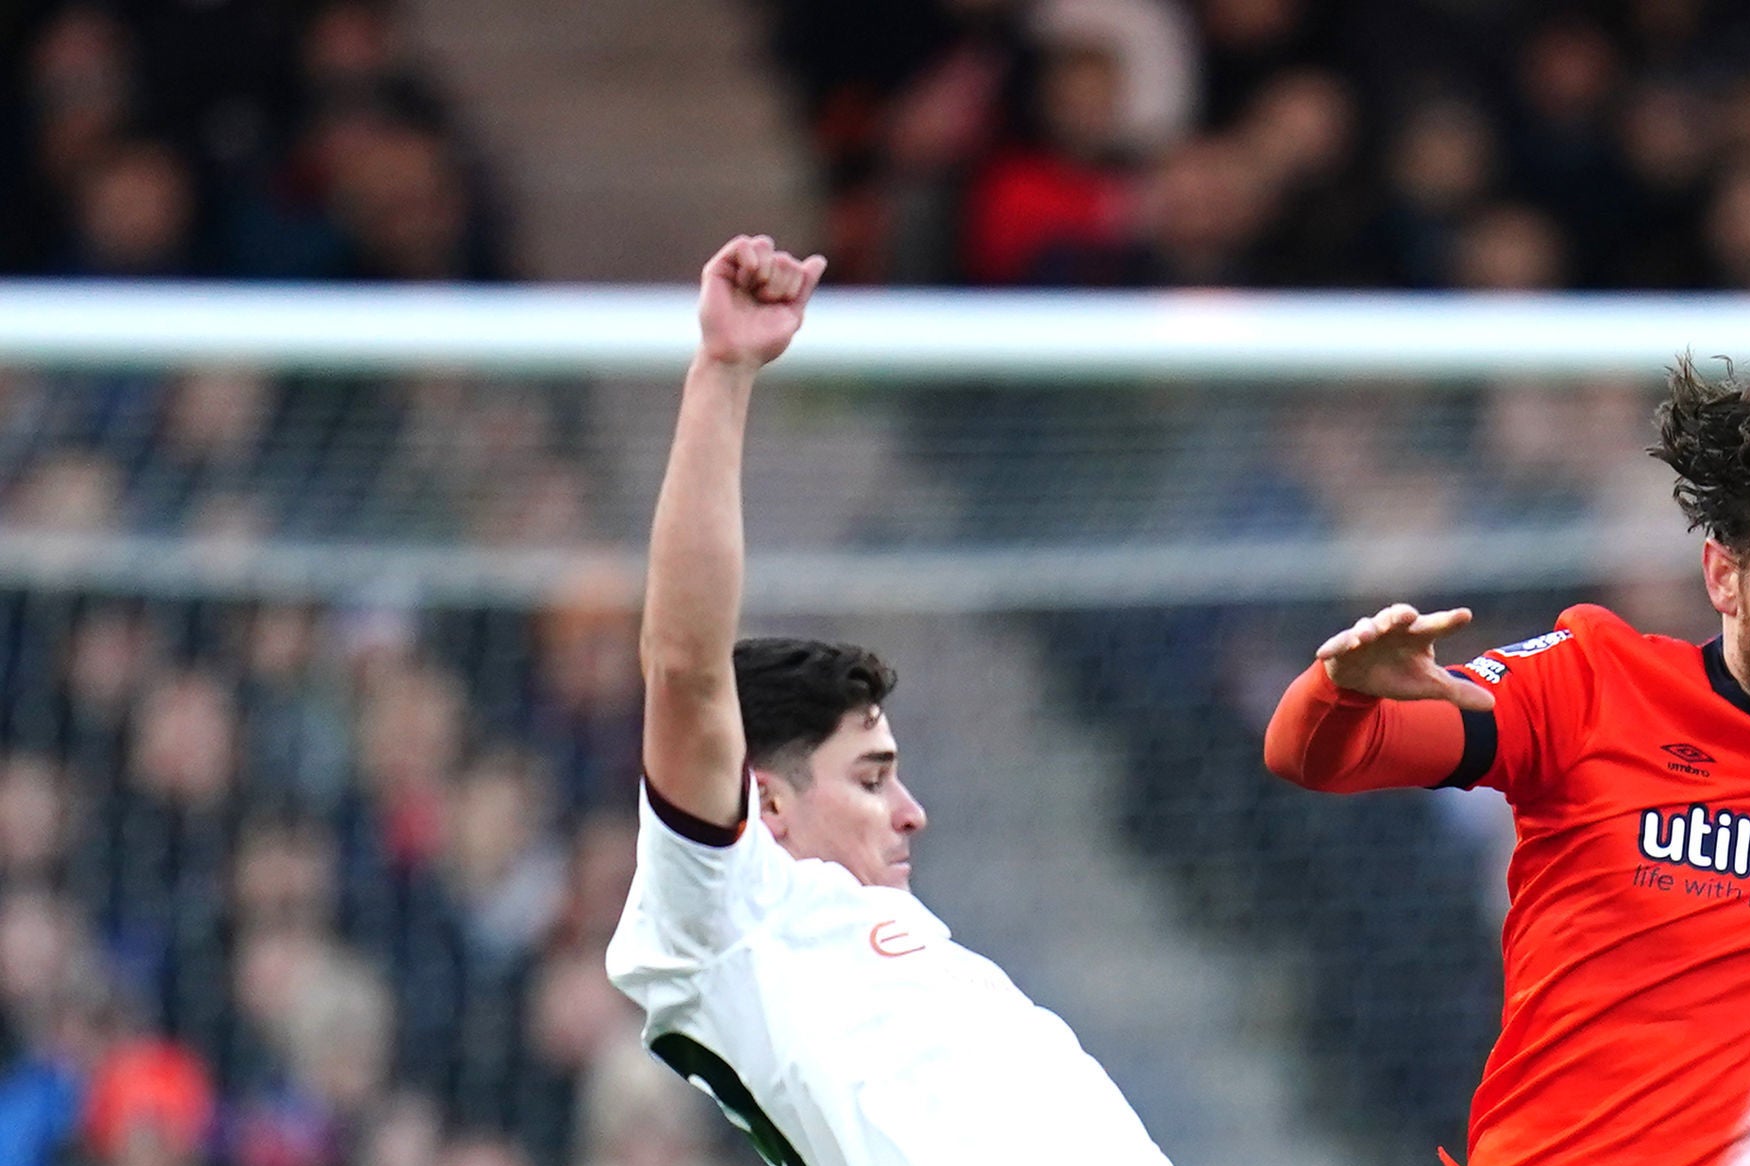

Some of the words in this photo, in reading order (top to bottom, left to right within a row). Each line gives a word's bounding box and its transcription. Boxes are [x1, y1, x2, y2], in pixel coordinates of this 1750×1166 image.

[1667, 761, 1711, 778] umbro
[1633, 864, 1674, 891] life
[1684, 876, 1742, 900] with
